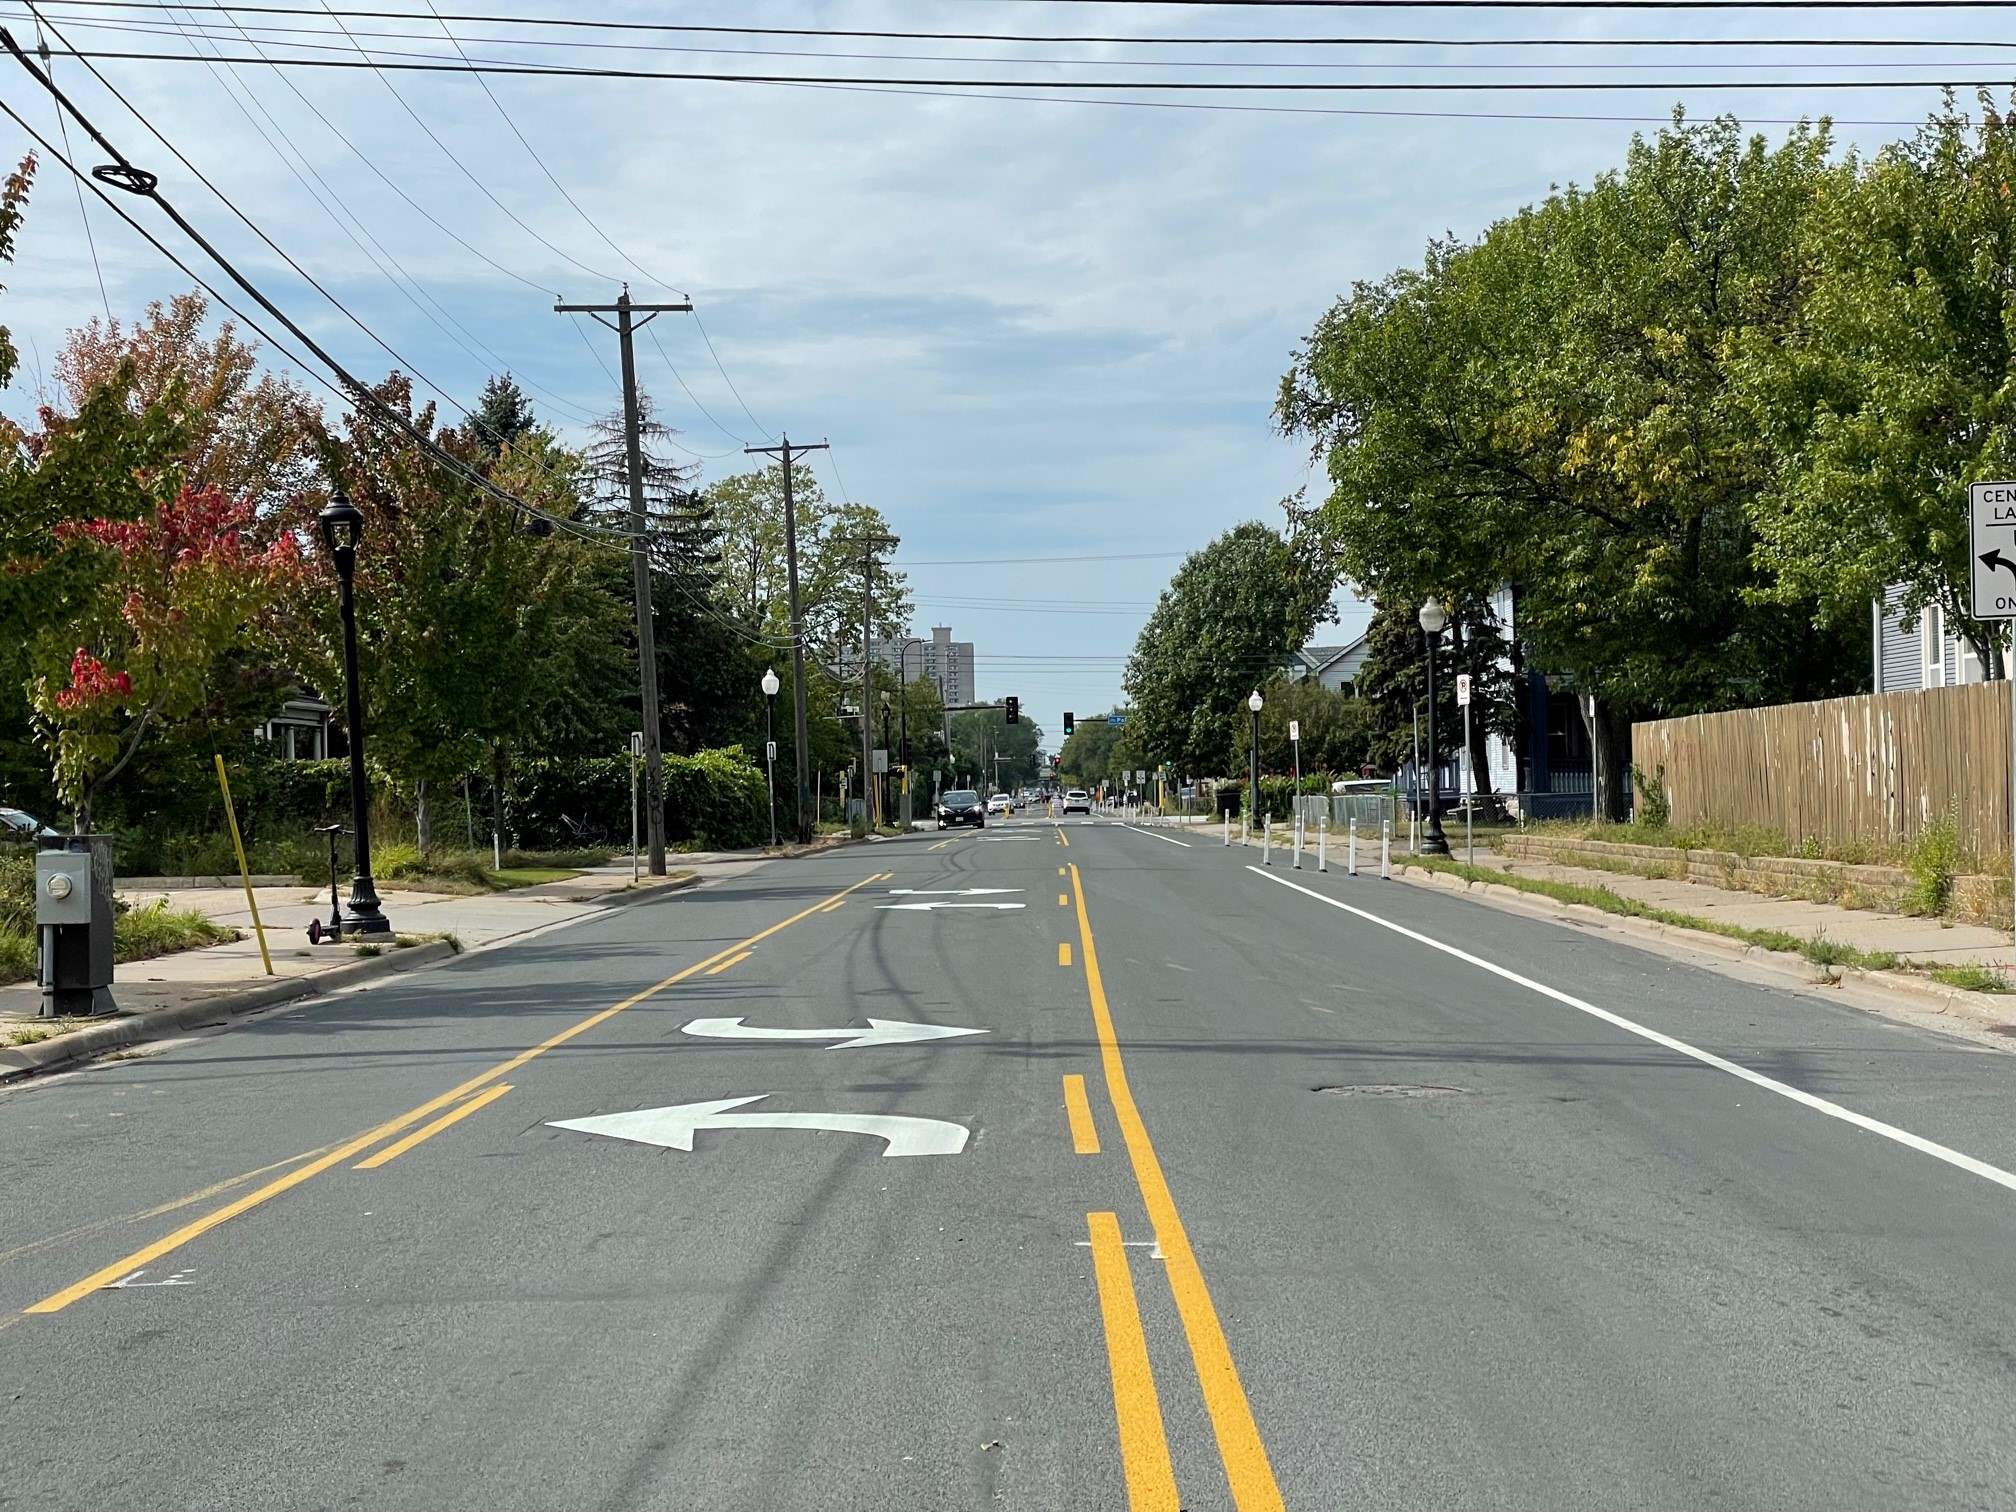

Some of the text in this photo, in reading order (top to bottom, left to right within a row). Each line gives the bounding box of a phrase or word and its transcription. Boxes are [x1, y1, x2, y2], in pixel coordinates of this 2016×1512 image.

[1984, 489, 2016, 502] CEN
[1994, 507, 2016, 519] LA
[1995, 596, 2016, 610] ON
